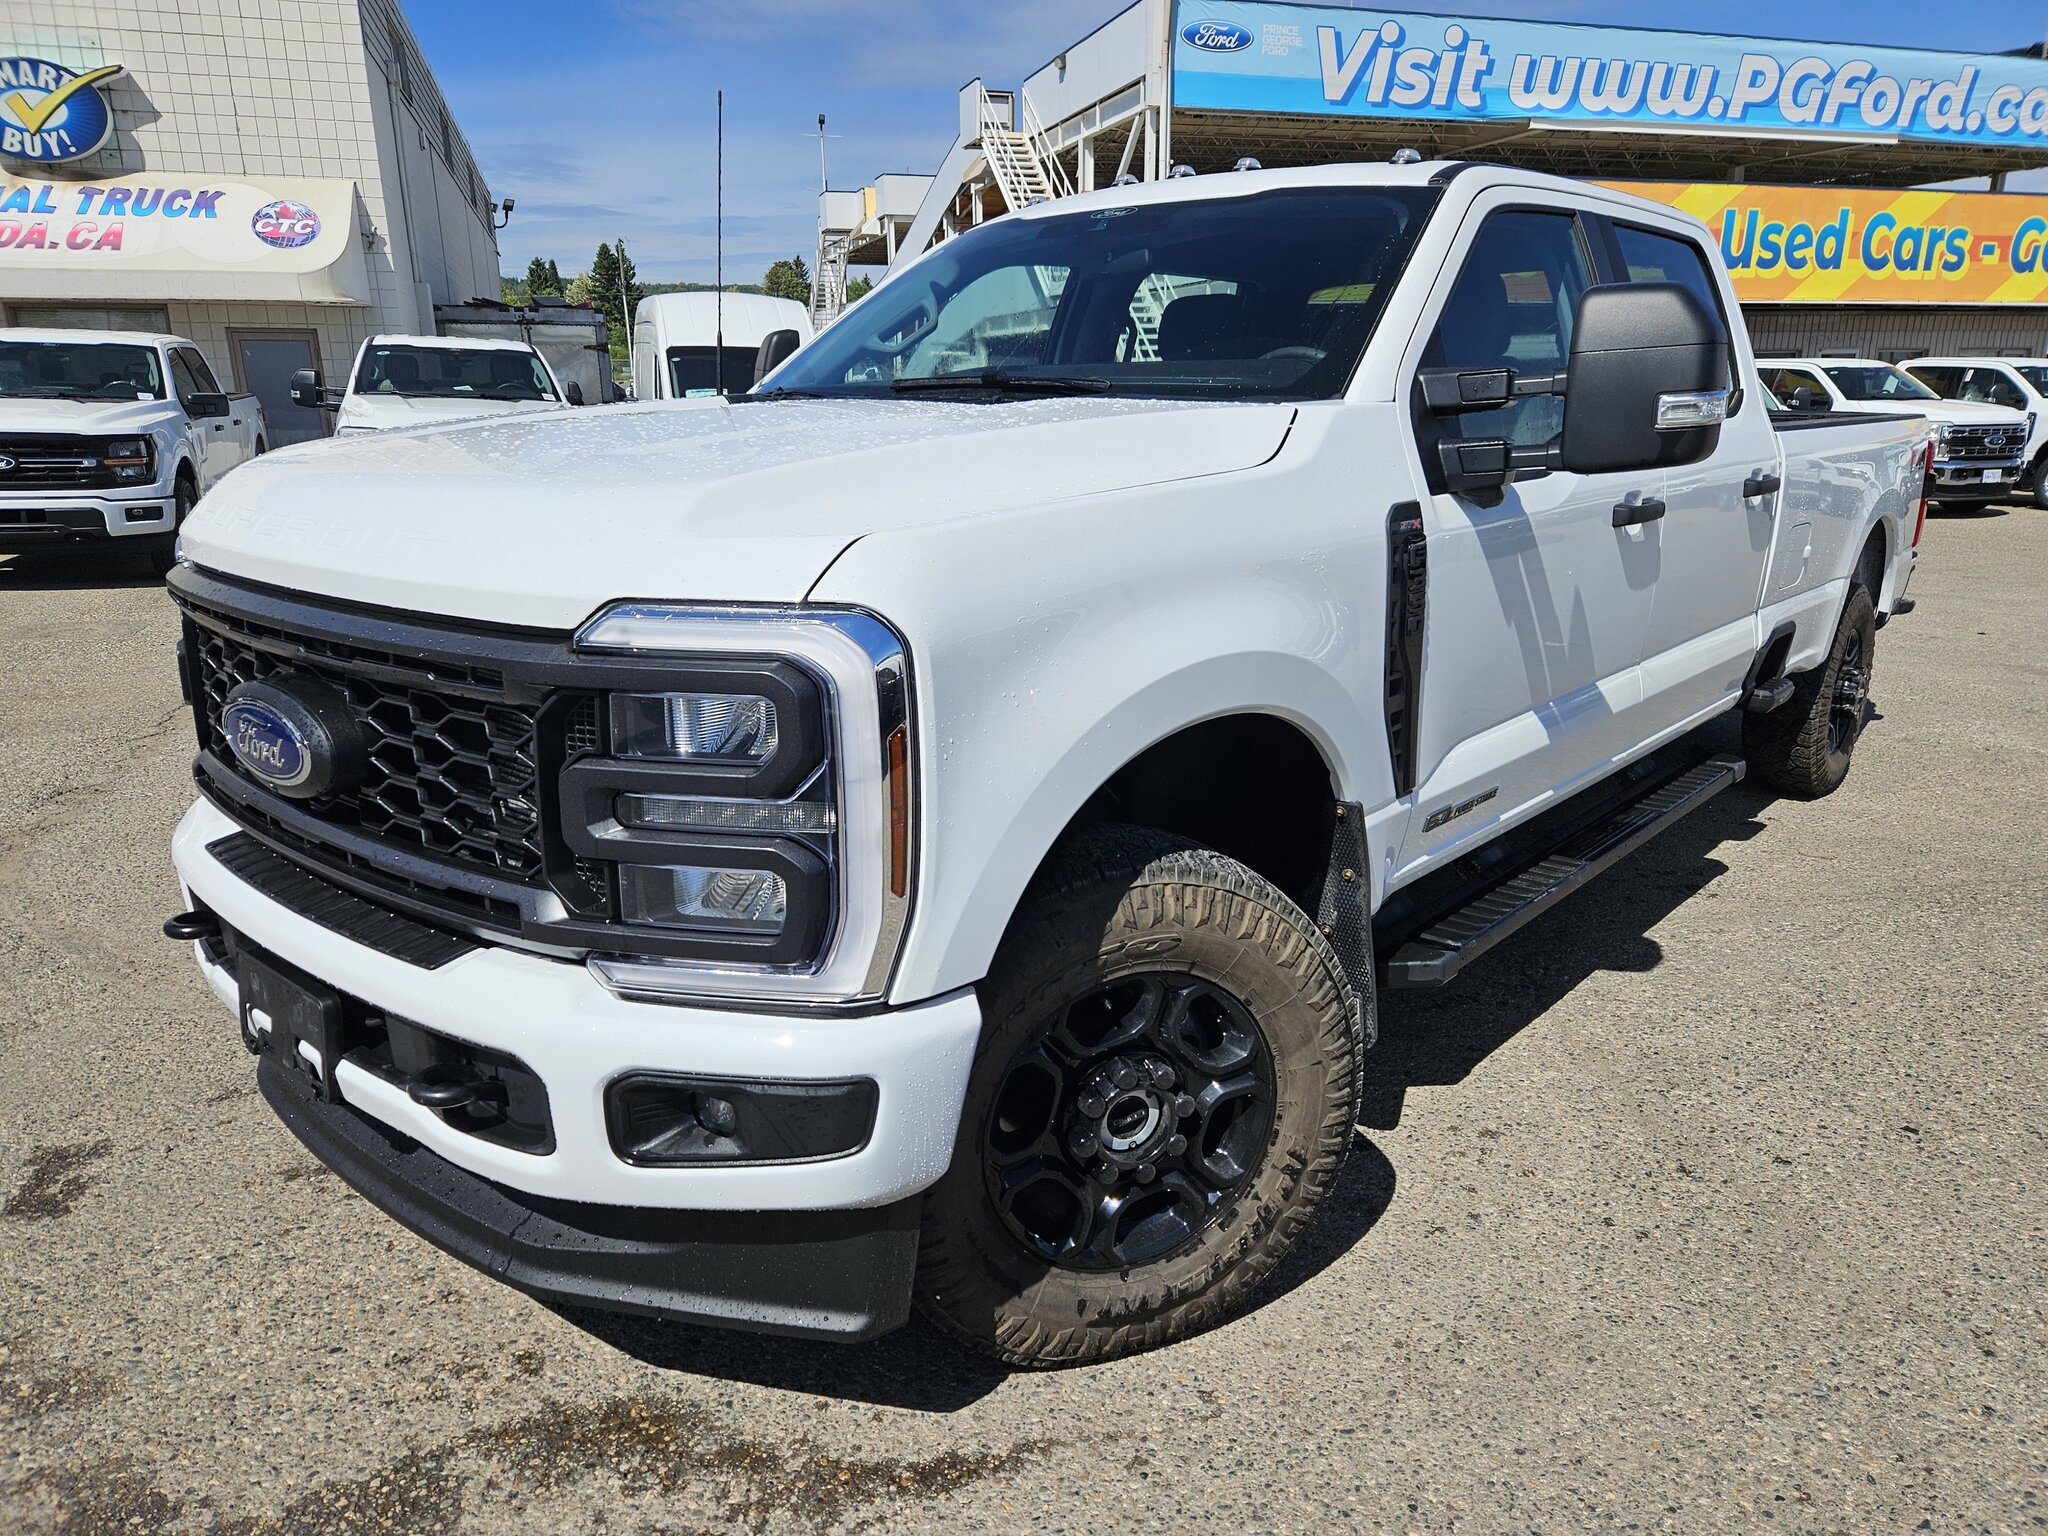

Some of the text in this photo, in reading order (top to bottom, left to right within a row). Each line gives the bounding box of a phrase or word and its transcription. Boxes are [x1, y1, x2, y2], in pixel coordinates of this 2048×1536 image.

[1194, 22, 1240, 49] Ford
[1262, 34, 1303, 47] GEORGE
[1263, 24, 1300, 36] PRINCE
[1262, 45, 1288, 56] FORD
[1316, 20, 1490, 108] Visit
[2, 126, 77, 158] BUY!
[0, 185, 226, 219] AL TRUCK
[255, 218, 316, 234] CTC
[1720, 207, 1852, 272] Used
[1861, 212, 1972, 273] Cars
[2011, 217, 2048, 275] G
[236, 713, 286, 769] Ford
